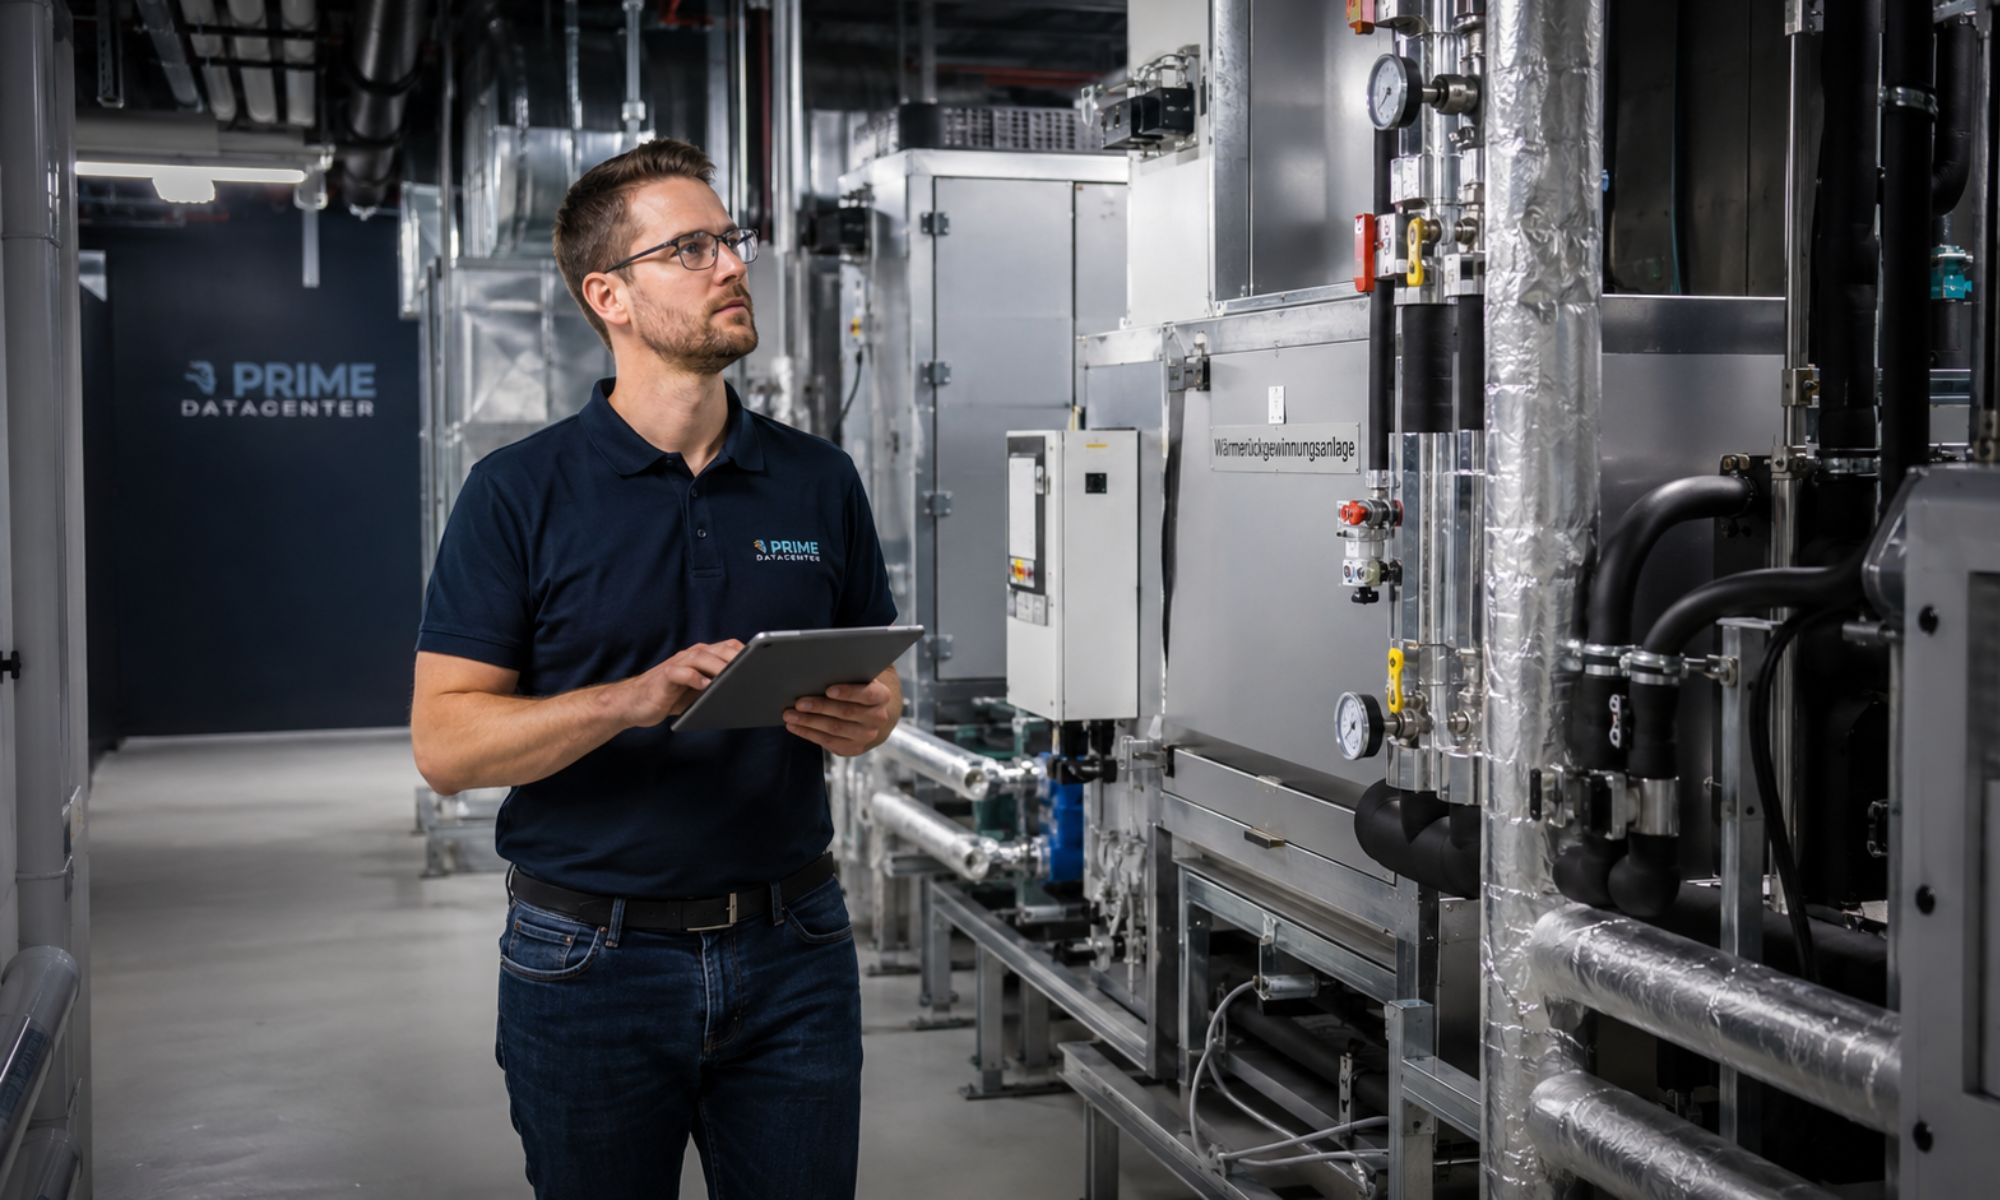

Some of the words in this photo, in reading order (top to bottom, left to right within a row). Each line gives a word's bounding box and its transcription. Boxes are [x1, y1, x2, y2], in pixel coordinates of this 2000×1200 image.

[233, 362, 377, 398] PRIME
[181, 399, 375, 417] DATACENTER
[770, 540, 820, 554] PRIME
